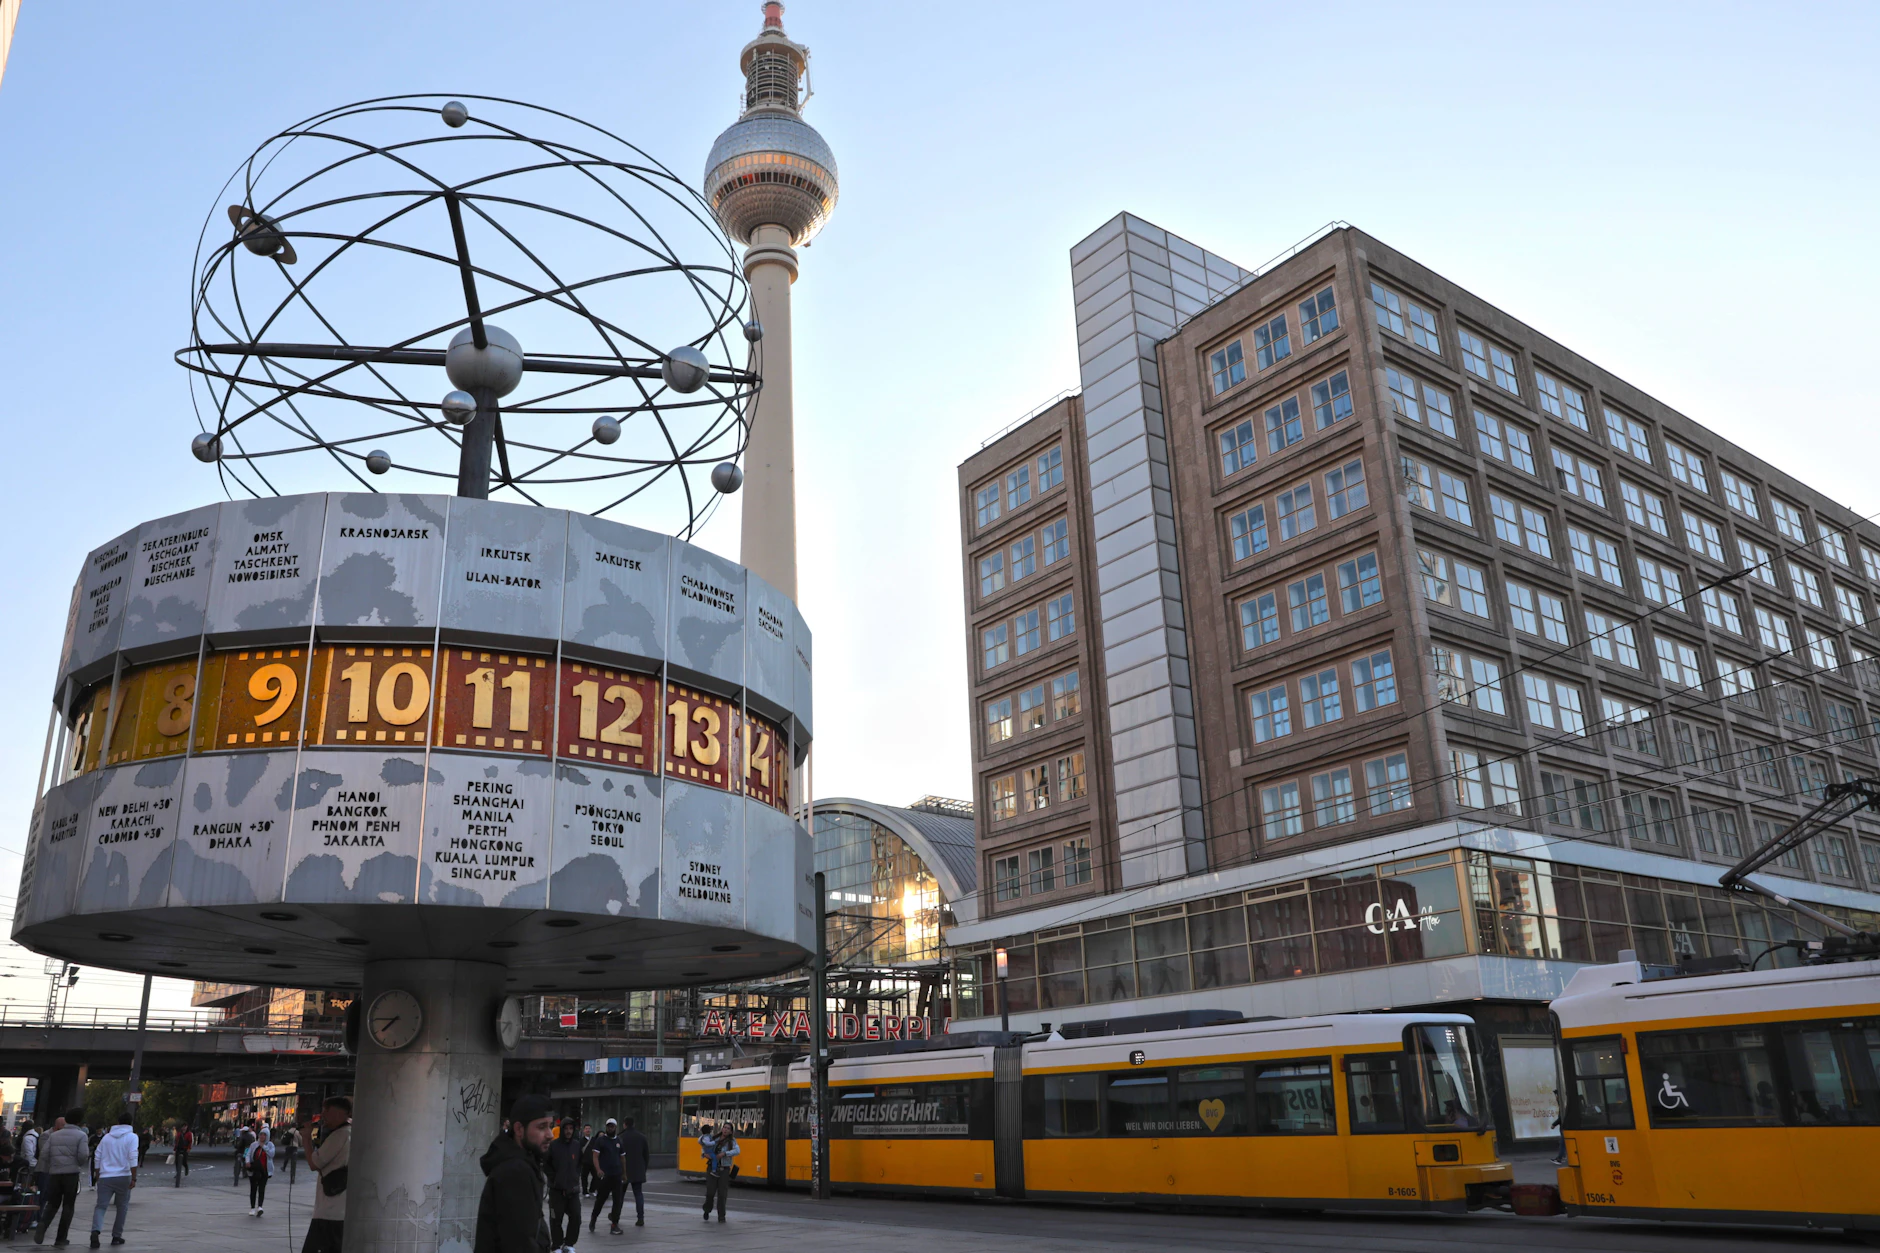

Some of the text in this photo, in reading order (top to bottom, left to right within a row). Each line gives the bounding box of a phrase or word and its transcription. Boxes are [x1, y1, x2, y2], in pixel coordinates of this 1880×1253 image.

[142, 528, 209, 553] JEKATERINBURG
[254, 531, 283, 543] OMSK
[340, 527, 429, 540] KRASNOJARSK
[148, 542, 199, 562] ASCHGABAT
[246, 543, 290, 557] ALMATY
[481, 547, 532, 562] IRKUTSK
[151, 556, 191, 574] BISCHKEK
[234, 556, 299, 570] TASCHKENT
[595, 552, 642, 572] JAKUTSK
[144, 567, 195, 587] DUSCHANBE
[228, 568, 300, 583] NOWOSIBIRSK
[466, 571, 541, 589] ULAN-BATOR
[681, 575, 735, 603] CHABAROWSK
[680, 586, 736, 615] WLADIWOSTOK
[758, 606, 784, 628] MAGADAN
[758, 617, 784, 641] SACHALIN
[248, 663, 298, 727] 9
[341, 661, 431, 726] 10
[465, 667, 531, 732] 11
[157, 673, 197, 737] 8
[572, 680, 643, 748] 12
[667, 700, 721, 766] 13
[736, 723, 770, 788] 14
[467, 781, 513, 795] PEKING
[338, 791, 380, 803] HANOI
[453, 794, 524, 810] SHANGHAI
[98, 804, 119, 818] NEW
[122, 801, 150, 815] DELHI
[327, 806, 388, 818] BANGKOK
[462, 810, 514, 824] MANILA
[575, 804, 641, 823] PJÖNGJANG
[111, 814, 154, 830] KARACHI
[193, 822, 242, 836] RANGUN
[312, 820, 401, 833] PHNOM PENH
[592, 821, 625, 836] TOKYO
[98, 831, 140, 845] COLOMBO
[467, 824, 507, 838] PERTH
[209, 836, 252, 849] DHAKA
[324, 836, 385, 848] JAKARTA
[450, 838, 523, 853] HONGKONG
[590, 834, 625, 849] SEOUL
[435, 851, 535, 868] KUALA LUMPUR
[451, 867, 517, 882] SINGAPUR
[689, 861, 722, 876] SYDNEY
[680, 873, 730, 891] CANBERRA
[678, 885, 732, 904] MELBOURNE
[1365, 898, 1441, 935] C&A Alex
[622, 1057, 632, 1071] U
[787, 1106, 804, 1123] DER
[830, 1102, 898, 1123] ZWEIGLEISIG
[900, 1100, 940, 1122] FÄHRT.
[1205, 1108, 1219, 1118] BVG
[1125, 1120, 1203, 1131] WEIL WIR DICH LIEBEN.
[1609, 1160, 1621, 1168] BVG
[1388, 1187, 1417, 1197] B-1605
[1586, 1193, 1616, 1204] 1506-A
